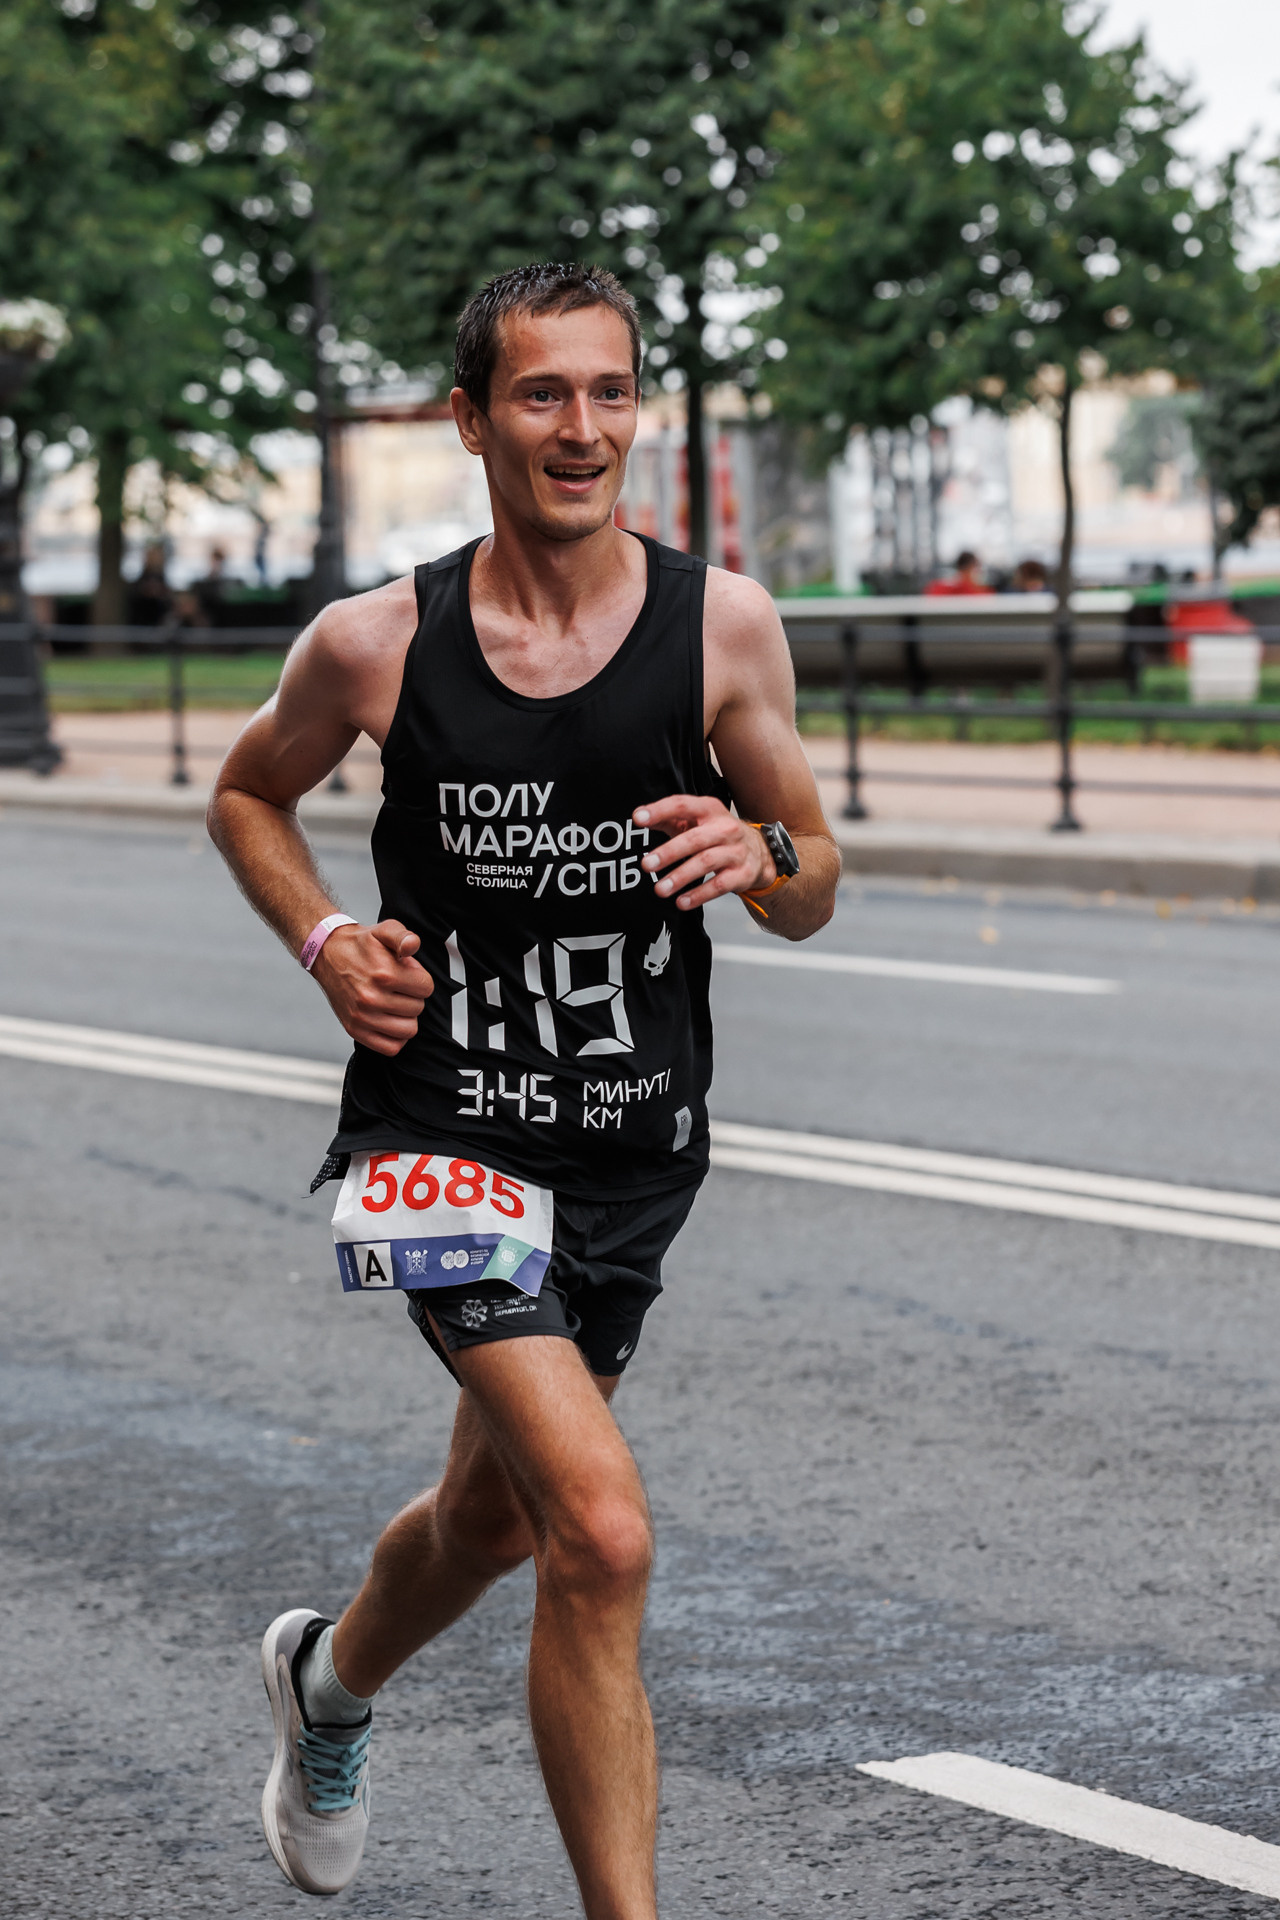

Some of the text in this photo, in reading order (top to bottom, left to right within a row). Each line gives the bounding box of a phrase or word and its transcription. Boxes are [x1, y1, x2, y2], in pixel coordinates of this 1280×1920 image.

[438, 781, 555, 818] ПОЛУ
[439, 818, 649, 858] МАРАФОН
[466, 862, 533, 876] СЕВЕРНАЯ
[466, 875, 528, 890] СТОЛИЦА
[444, 929, 635, 1058] 1:19
[456, 1069, 557, 1123] 3:45
[582, 1105, 623, 1129] КМ
[361, 1152, 525, 1219] 5685
[365, 1249, 388, 1283] A
